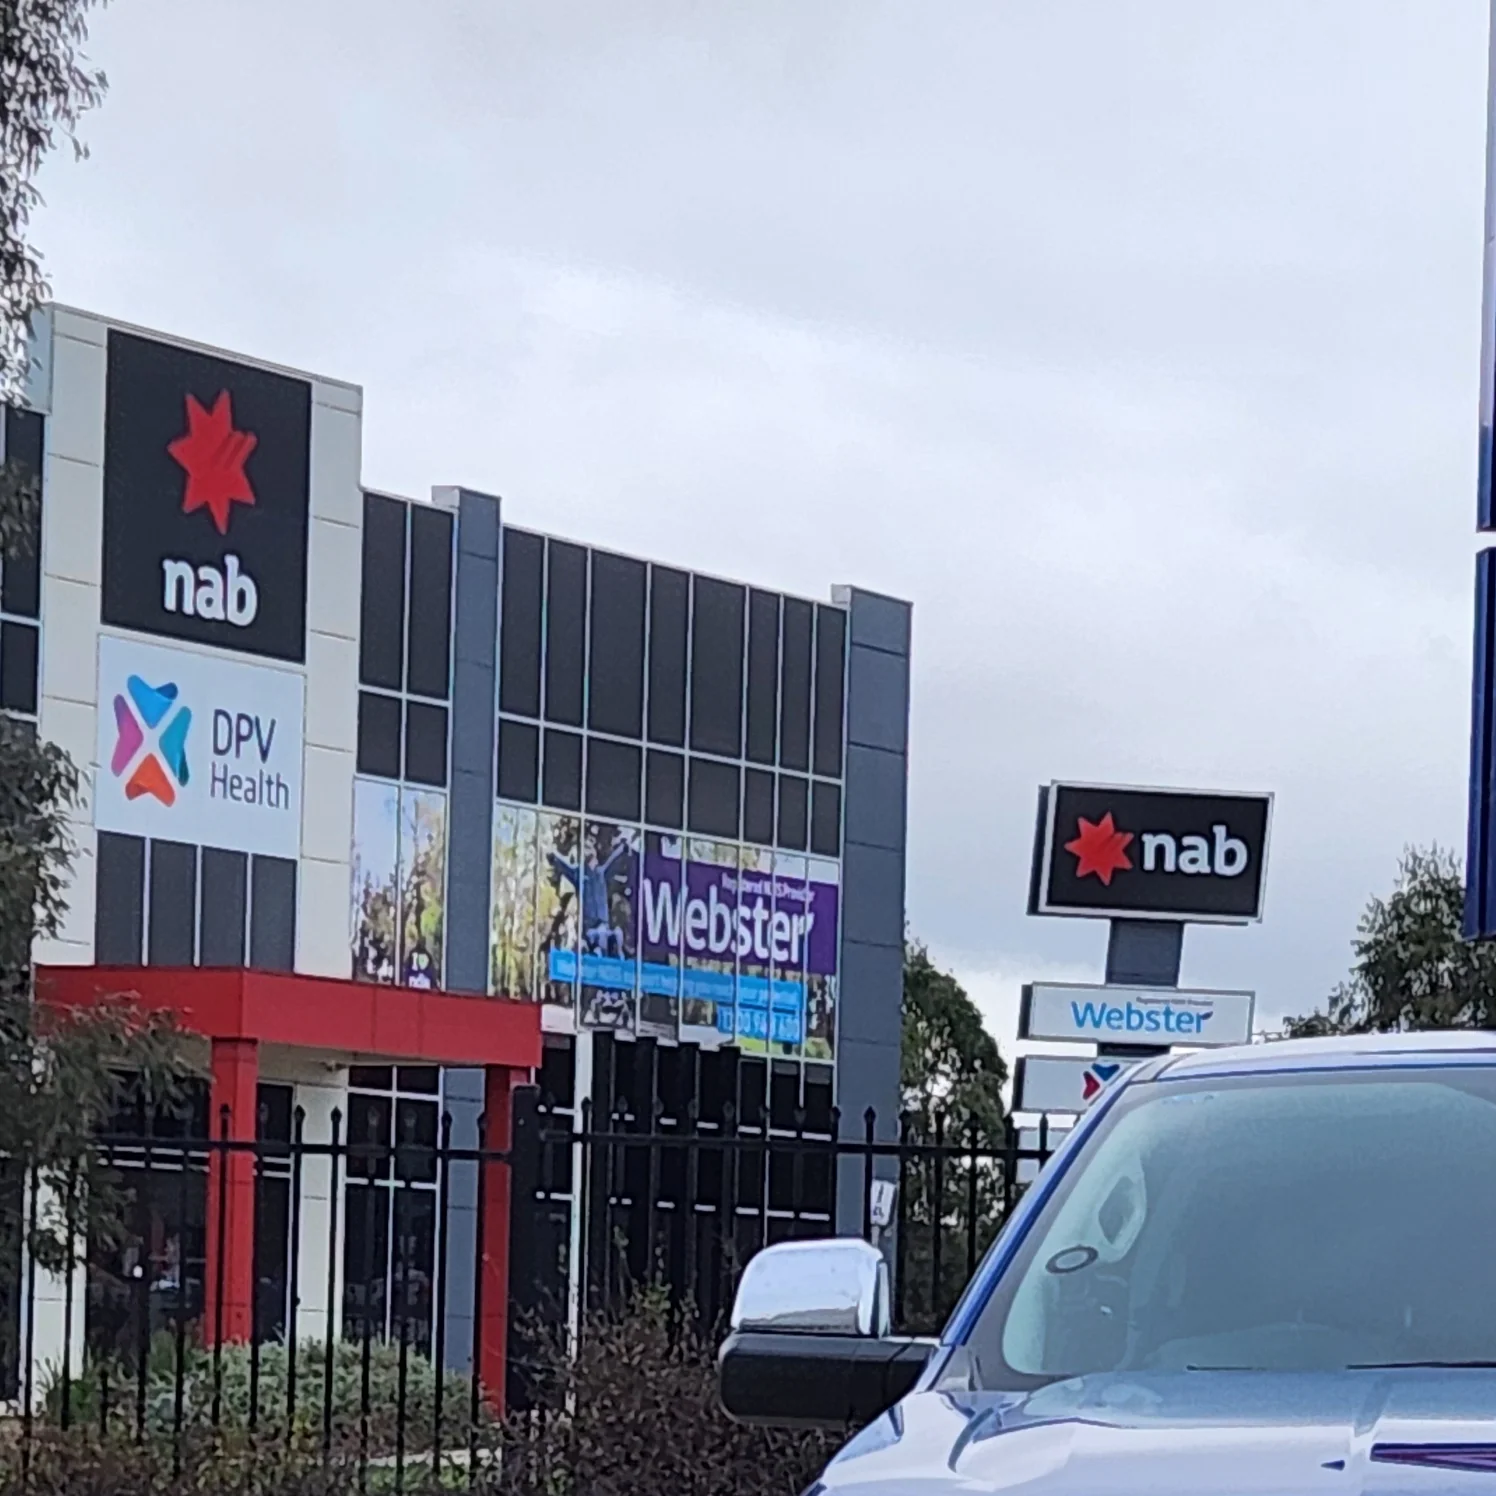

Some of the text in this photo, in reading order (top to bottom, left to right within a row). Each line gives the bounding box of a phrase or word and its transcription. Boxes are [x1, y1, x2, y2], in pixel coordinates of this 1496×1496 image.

[162, 553, 258, 627] nab
[212, 708, 276, 764] DPV
[210, 761, 290, 810] Health
[1141, 824, 1248, 877] nab
[643, 878, 814, 963] Webster
[1071, 1001, 1214, 1033] Webster
